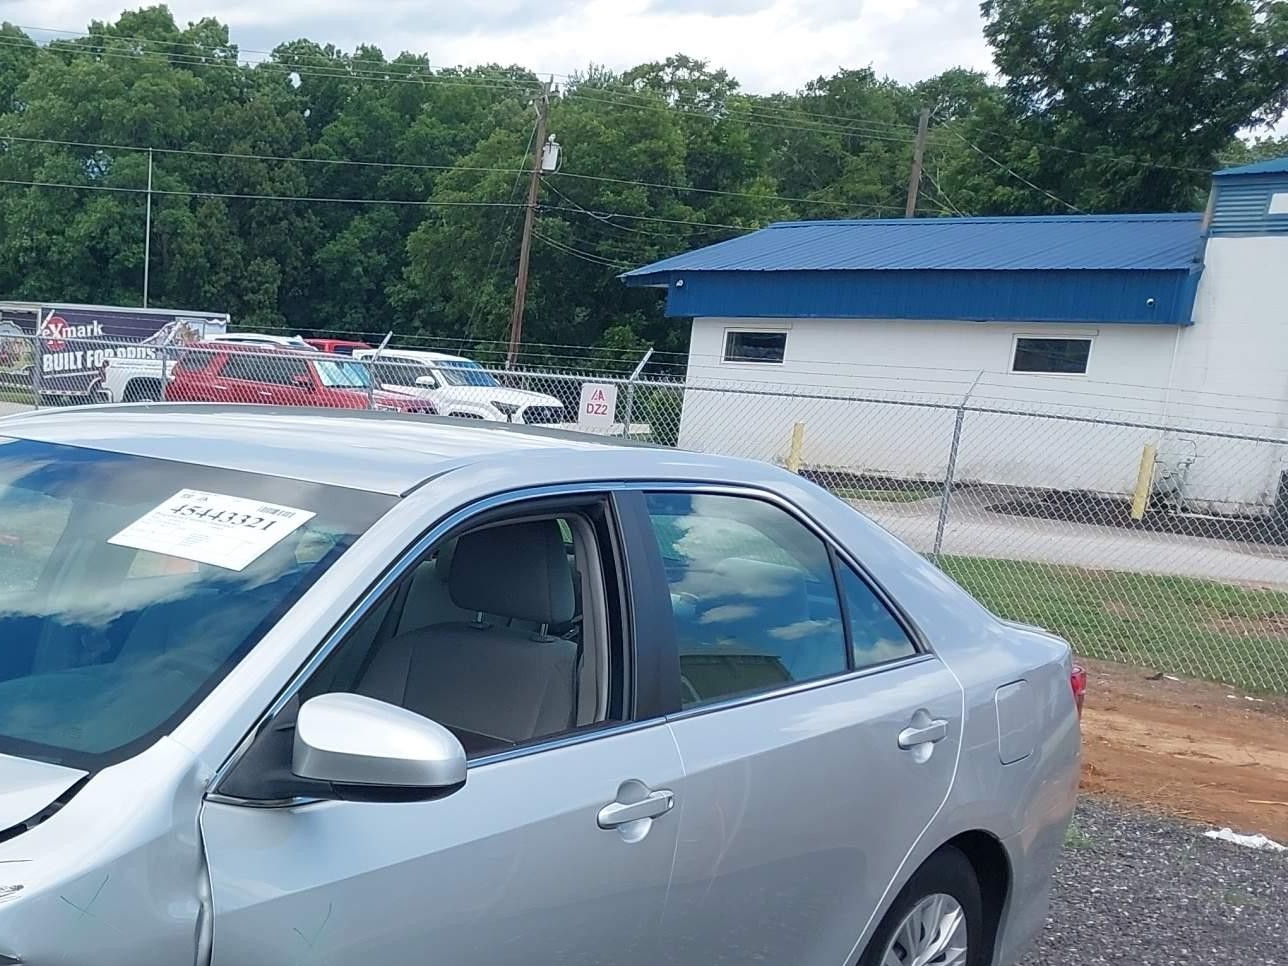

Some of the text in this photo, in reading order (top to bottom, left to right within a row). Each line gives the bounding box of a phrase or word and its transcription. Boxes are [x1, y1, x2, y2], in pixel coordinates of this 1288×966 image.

[43, 351, 83, 372] BUILT
[586, 403, 608, 415] DZ2
[170, 504, 277, 530] 45443321
